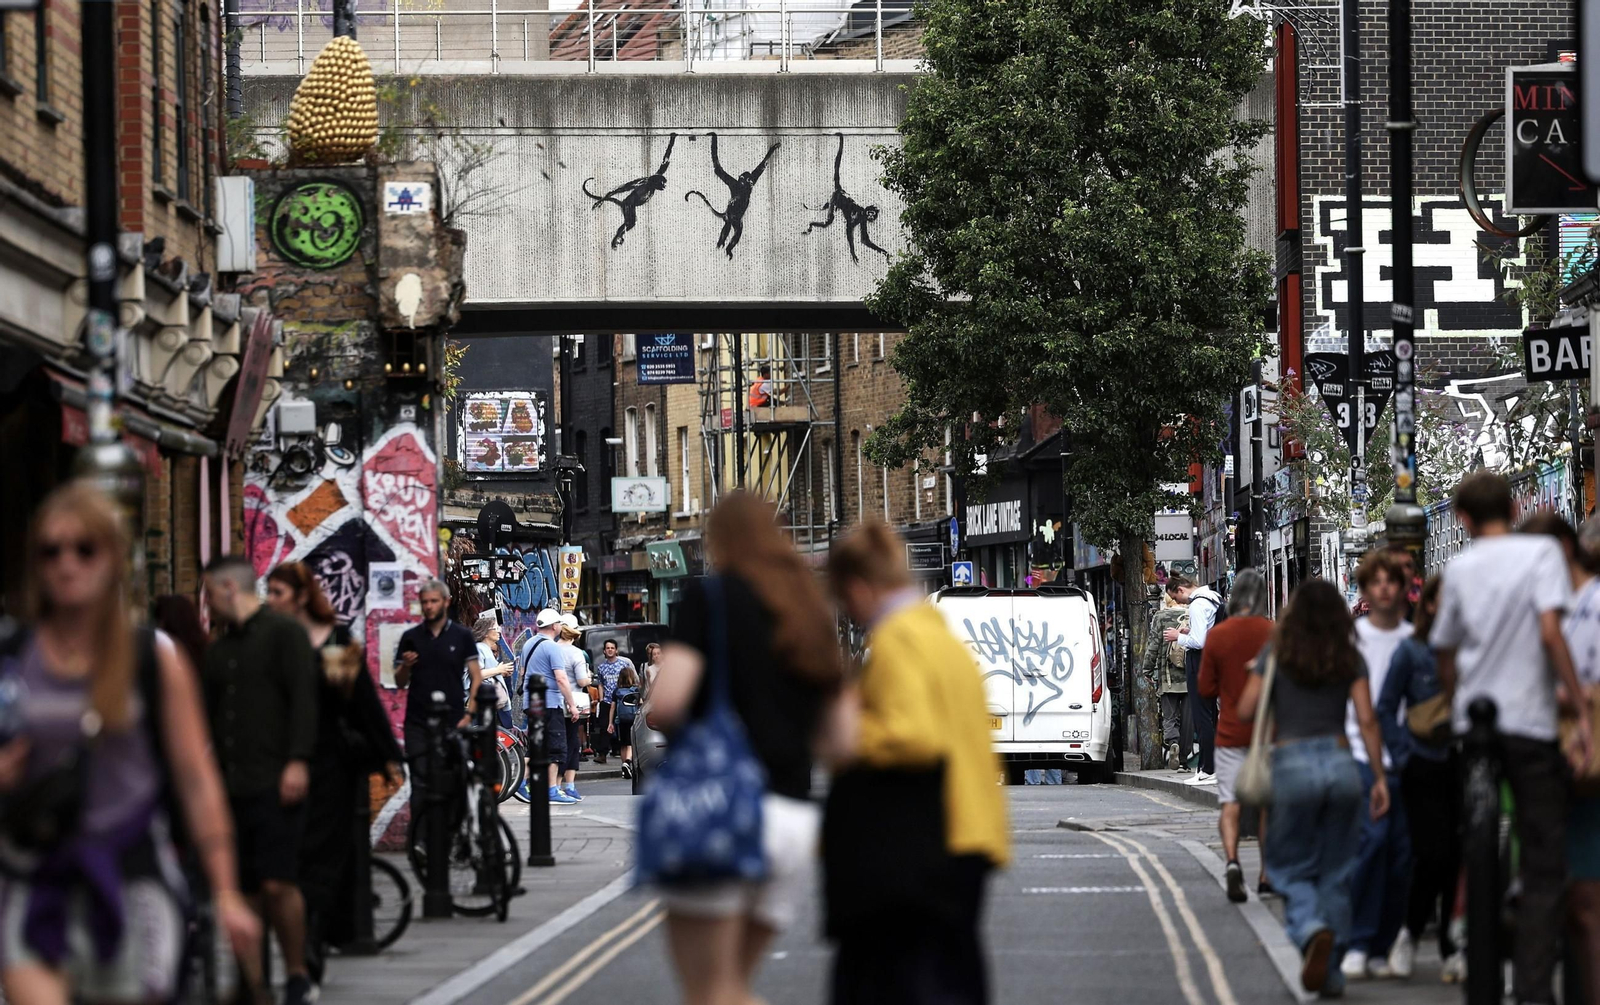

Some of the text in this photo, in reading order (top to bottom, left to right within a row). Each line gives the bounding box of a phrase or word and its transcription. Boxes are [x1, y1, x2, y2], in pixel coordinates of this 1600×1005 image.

[1516, 118, 1577, 144] CA
[641, 345, 688, 353] SCAFFOLDING
[966, 500, 1021, 536] BRICK LANE VINTAGE
[1165, 533, 1189, 541] LOCAL
[1062, 730, 1090, 739] COG
